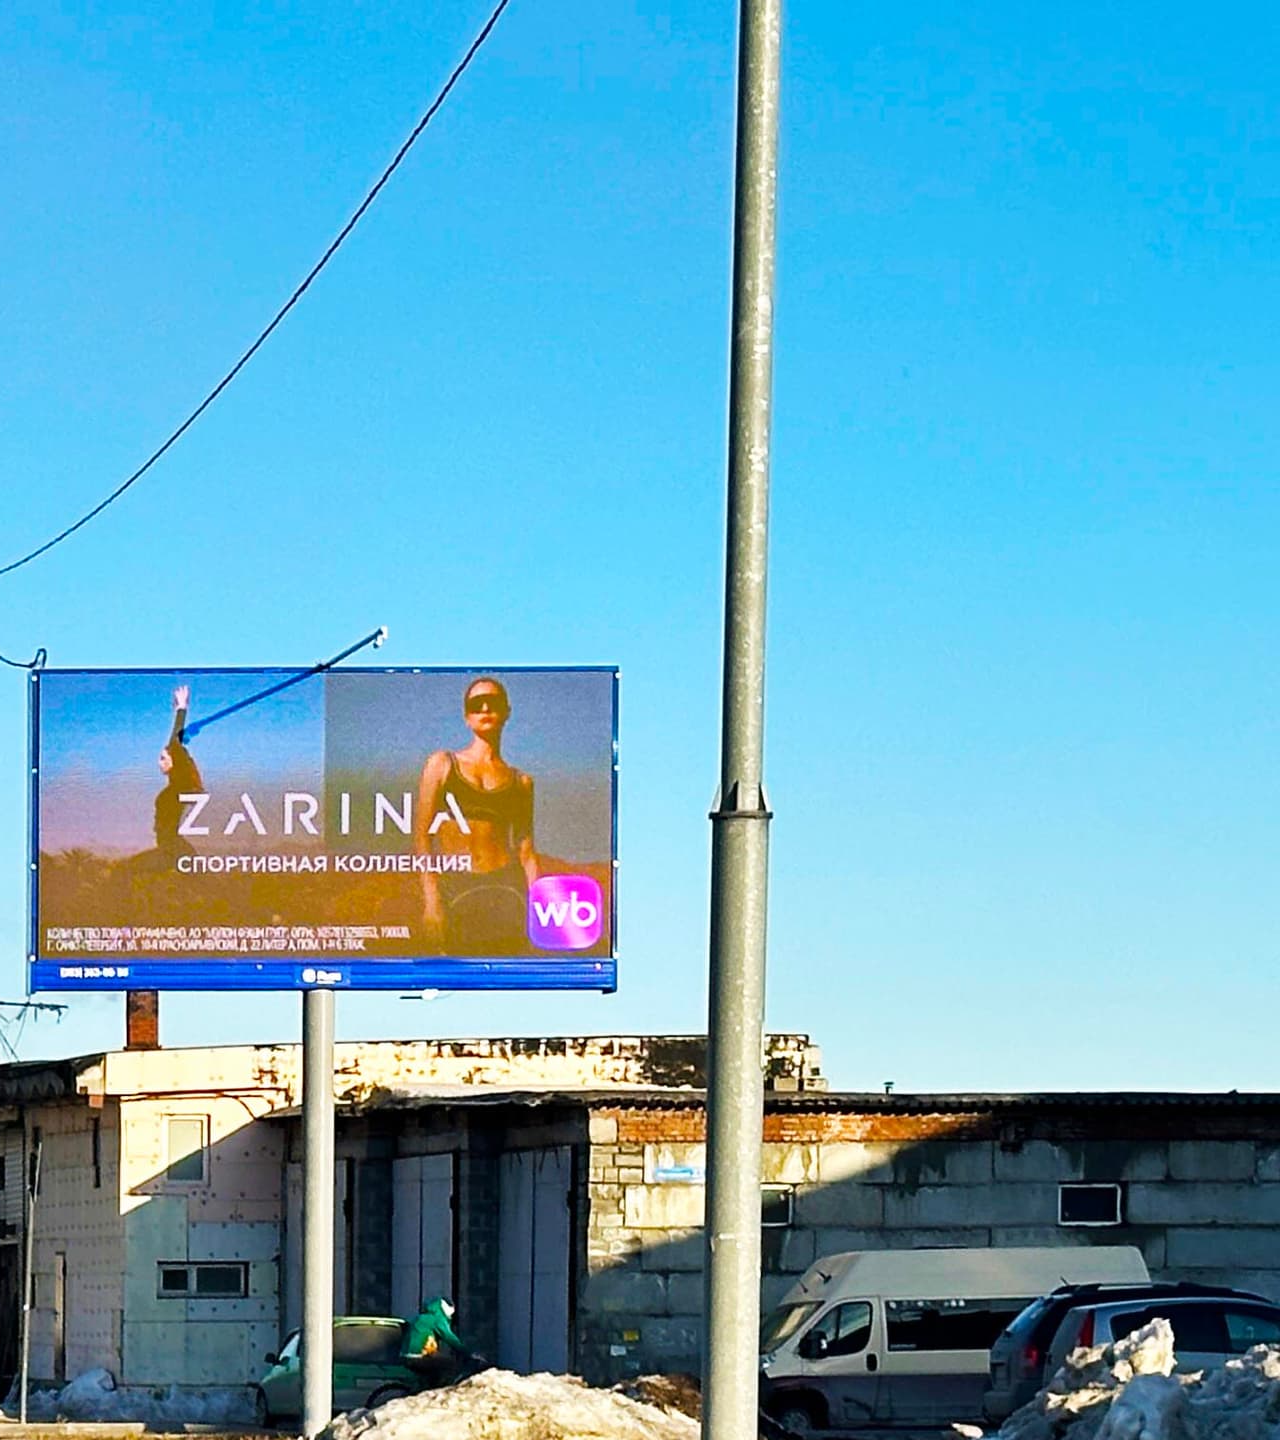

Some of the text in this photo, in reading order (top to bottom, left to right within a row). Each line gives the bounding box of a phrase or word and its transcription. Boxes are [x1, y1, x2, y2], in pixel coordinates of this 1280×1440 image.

[177, 792, 472, 836] ZARINA
[177, 854, 472, 874] СПОРТИВНАЯ КОЛЛЕКЦИЯ
[533, 890, 597, 928] wb
